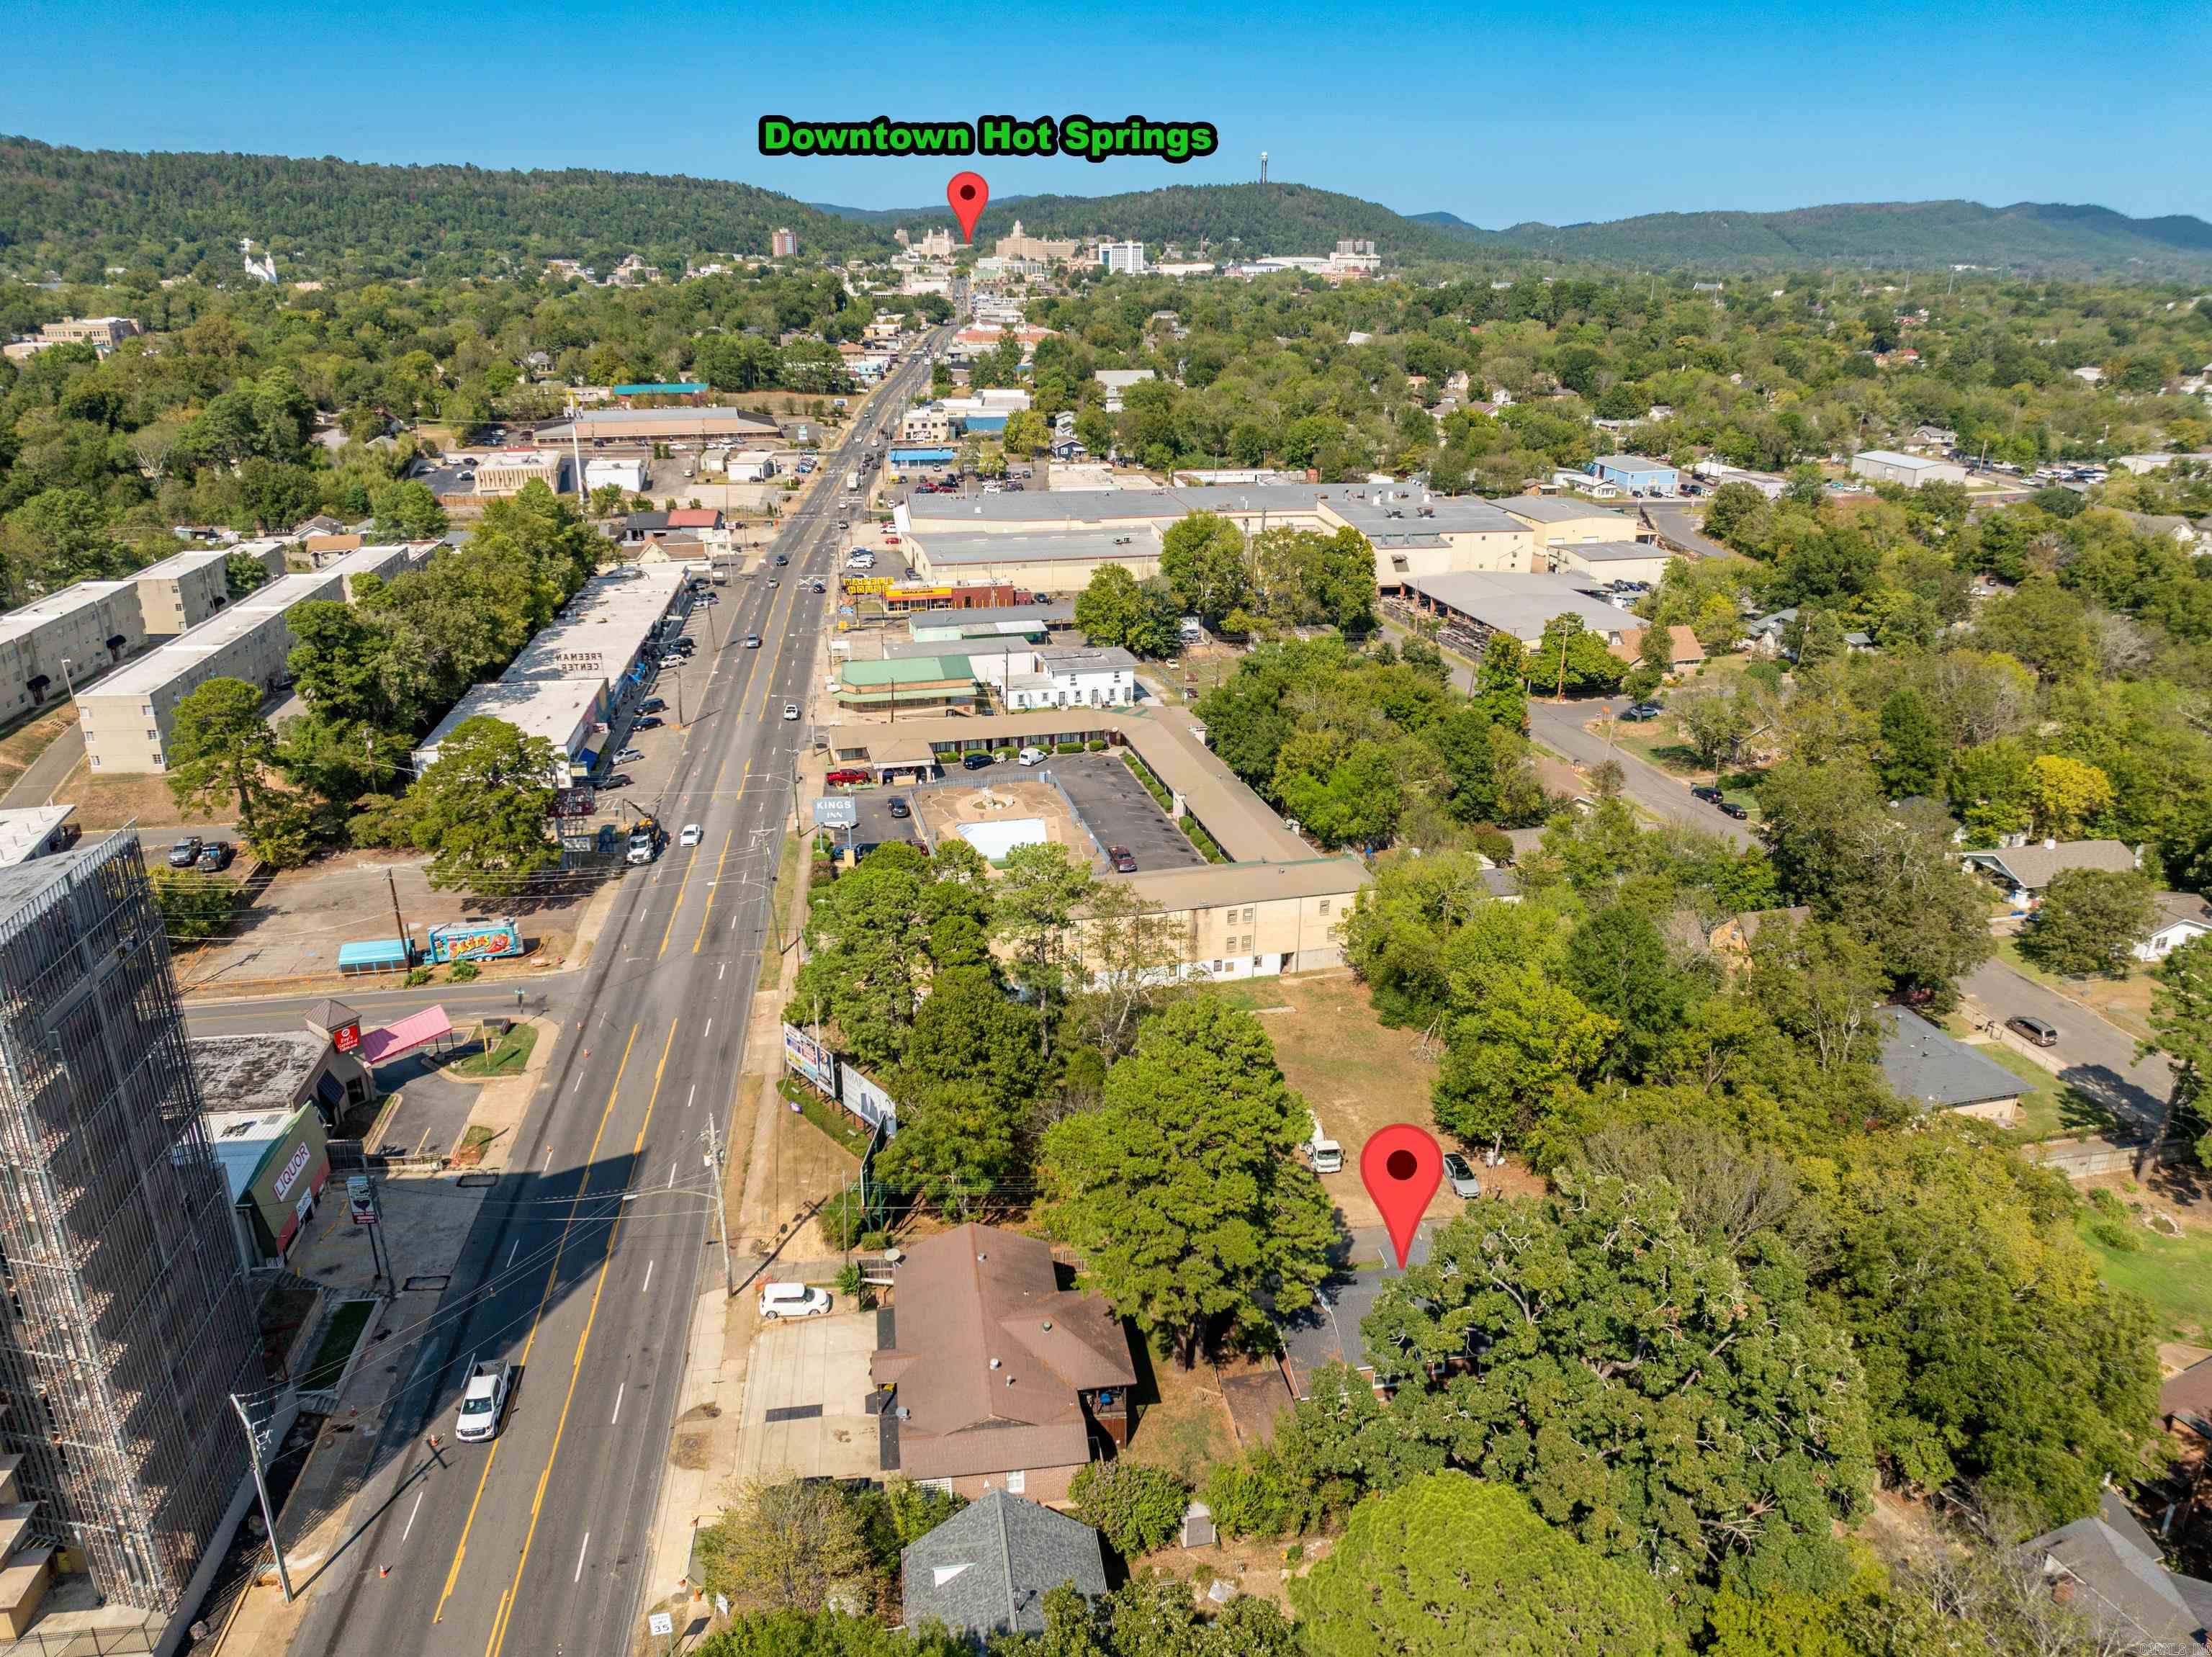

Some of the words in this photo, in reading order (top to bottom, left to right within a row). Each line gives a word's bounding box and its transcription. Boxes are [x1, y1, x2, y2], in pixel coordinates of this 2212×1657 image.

[817, 800, 852, 810] KINGS
[275, 1146, 308, 1195] LIQUOR
[654, 1624, 670, 1633] 35
